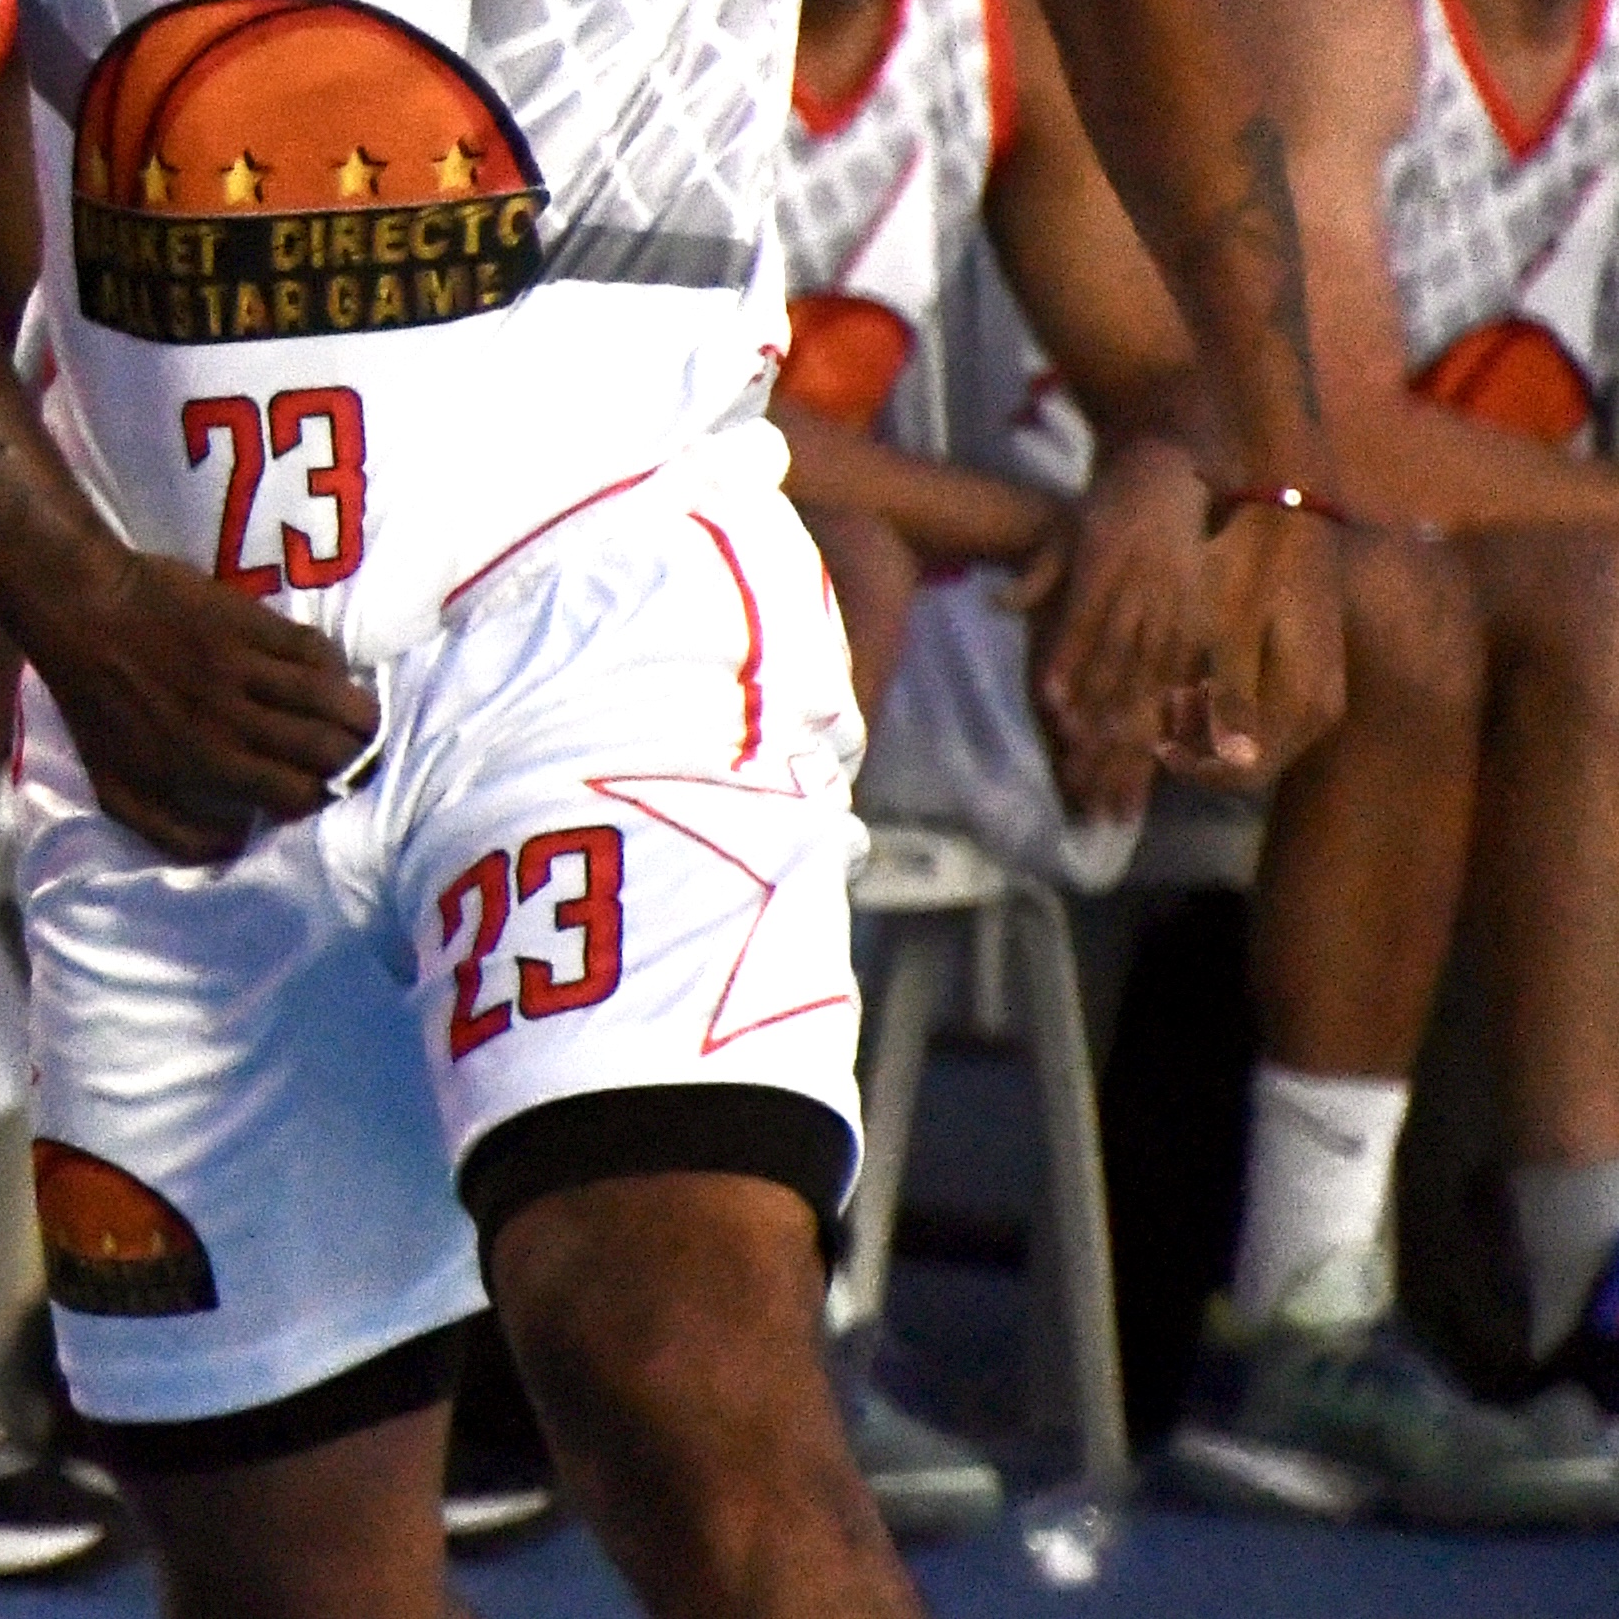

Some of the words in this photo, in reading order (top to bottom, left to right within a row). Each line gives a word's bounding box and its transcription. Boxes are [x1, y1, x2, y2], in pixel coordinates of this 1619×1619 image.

[327, 263, 501, 328] GAME
[181, 385, 366, 597] 23
[438, 823, 625, 1062] 23
